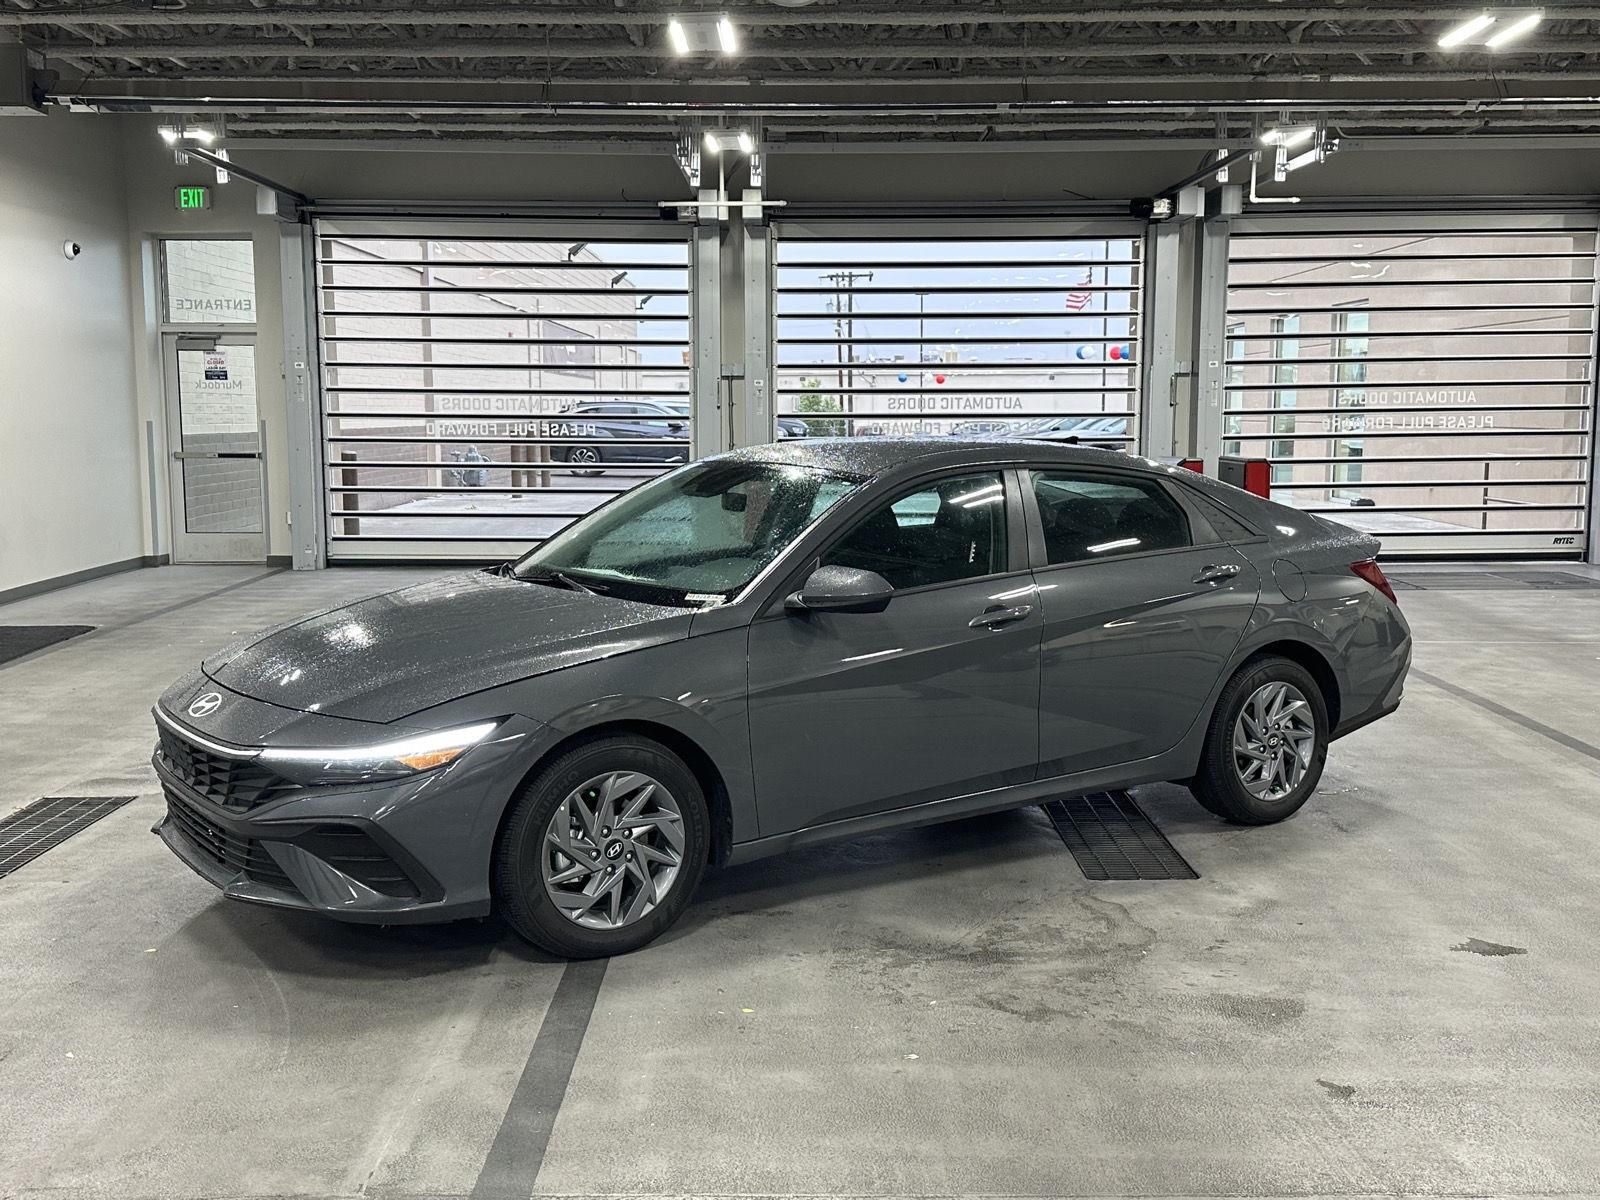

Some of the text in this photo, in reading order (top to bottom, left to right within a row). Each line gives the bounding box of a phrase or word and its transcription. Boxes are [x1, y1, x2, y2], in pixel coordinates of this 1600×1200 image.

[180, 188, 204, 208] EXIT
[1552, 537, 1575, 545] RYTEC
[532, 770, 579, 826] KUMHO
